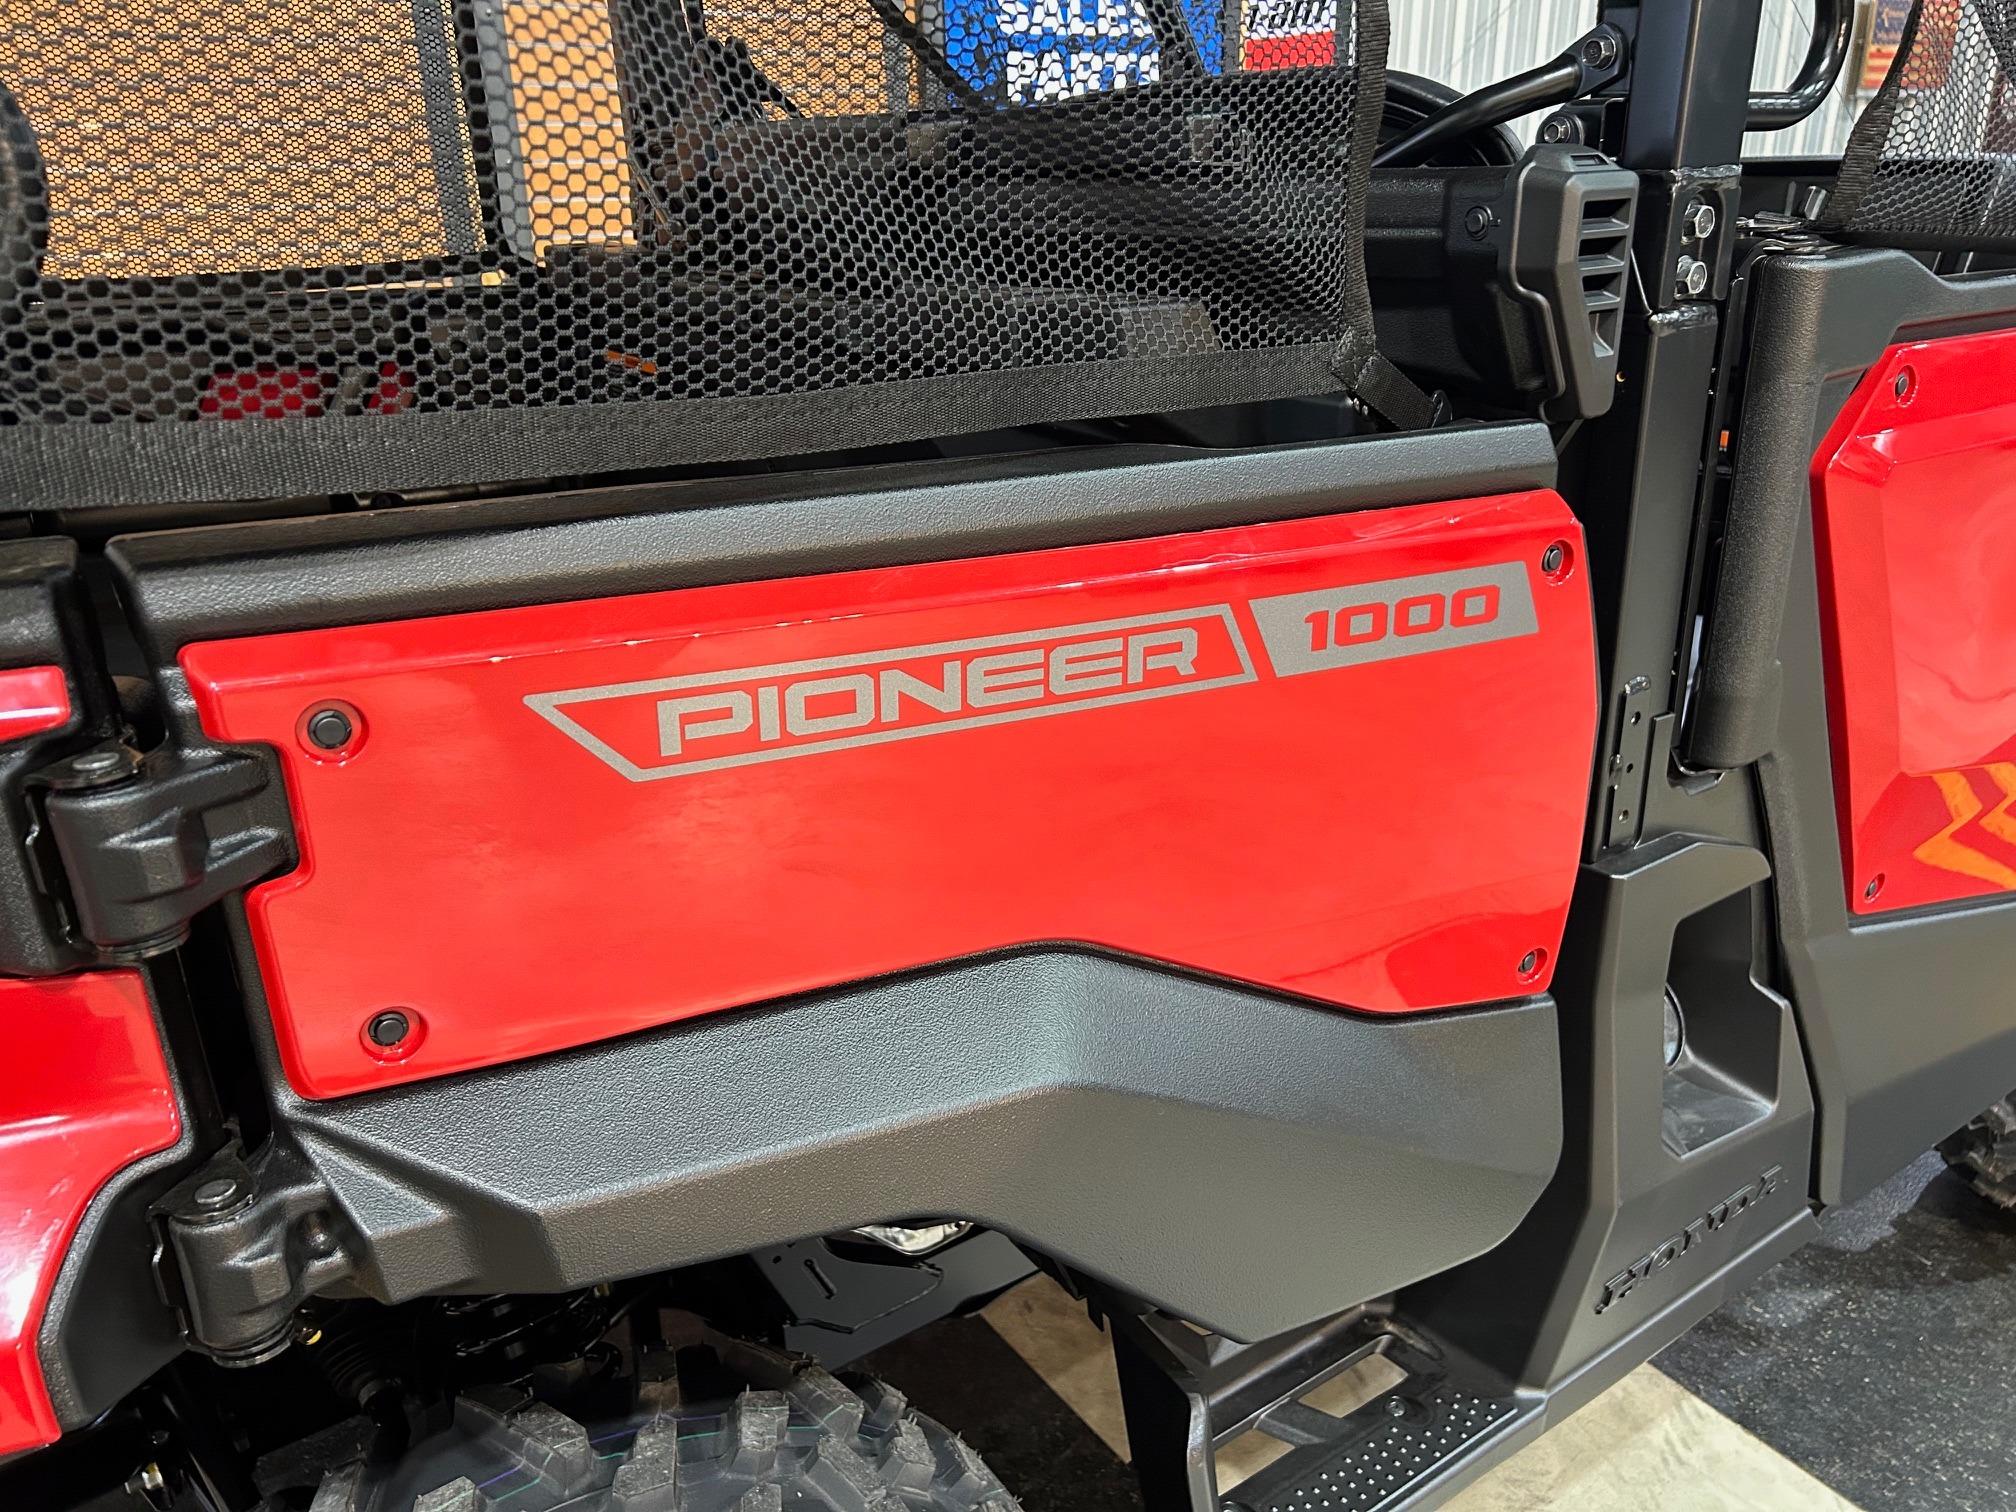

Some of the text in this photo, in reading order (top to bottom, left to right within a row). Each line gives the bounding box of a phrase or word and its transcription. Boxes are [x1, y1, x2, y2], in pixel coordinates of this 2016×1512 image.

[656, 584, 1500, 757] PIONEER 1000
[1594, 1164, 1786, 1315] HONDA
